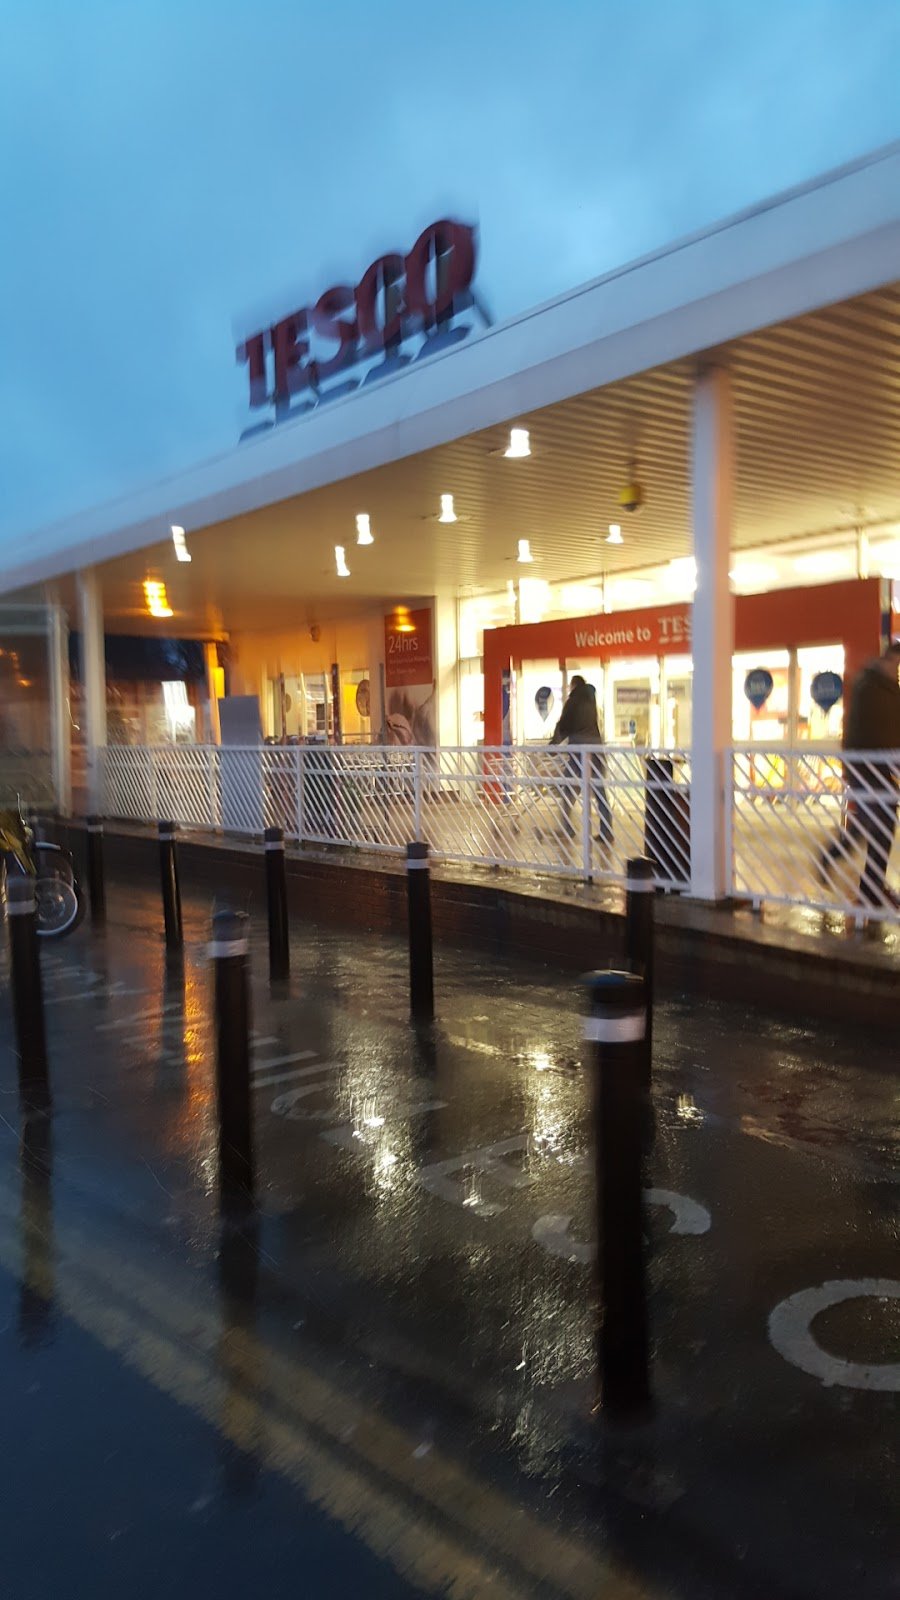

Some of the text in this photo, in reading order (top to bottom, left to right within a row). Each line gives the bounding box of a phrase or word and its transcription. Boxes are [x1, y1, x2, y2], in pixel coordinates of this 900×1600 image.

[235, 219, 477, 411] TESCO
[388, 632, 419, 653] 24hrs
[575, 614, 693, 648] Welcome to TES
